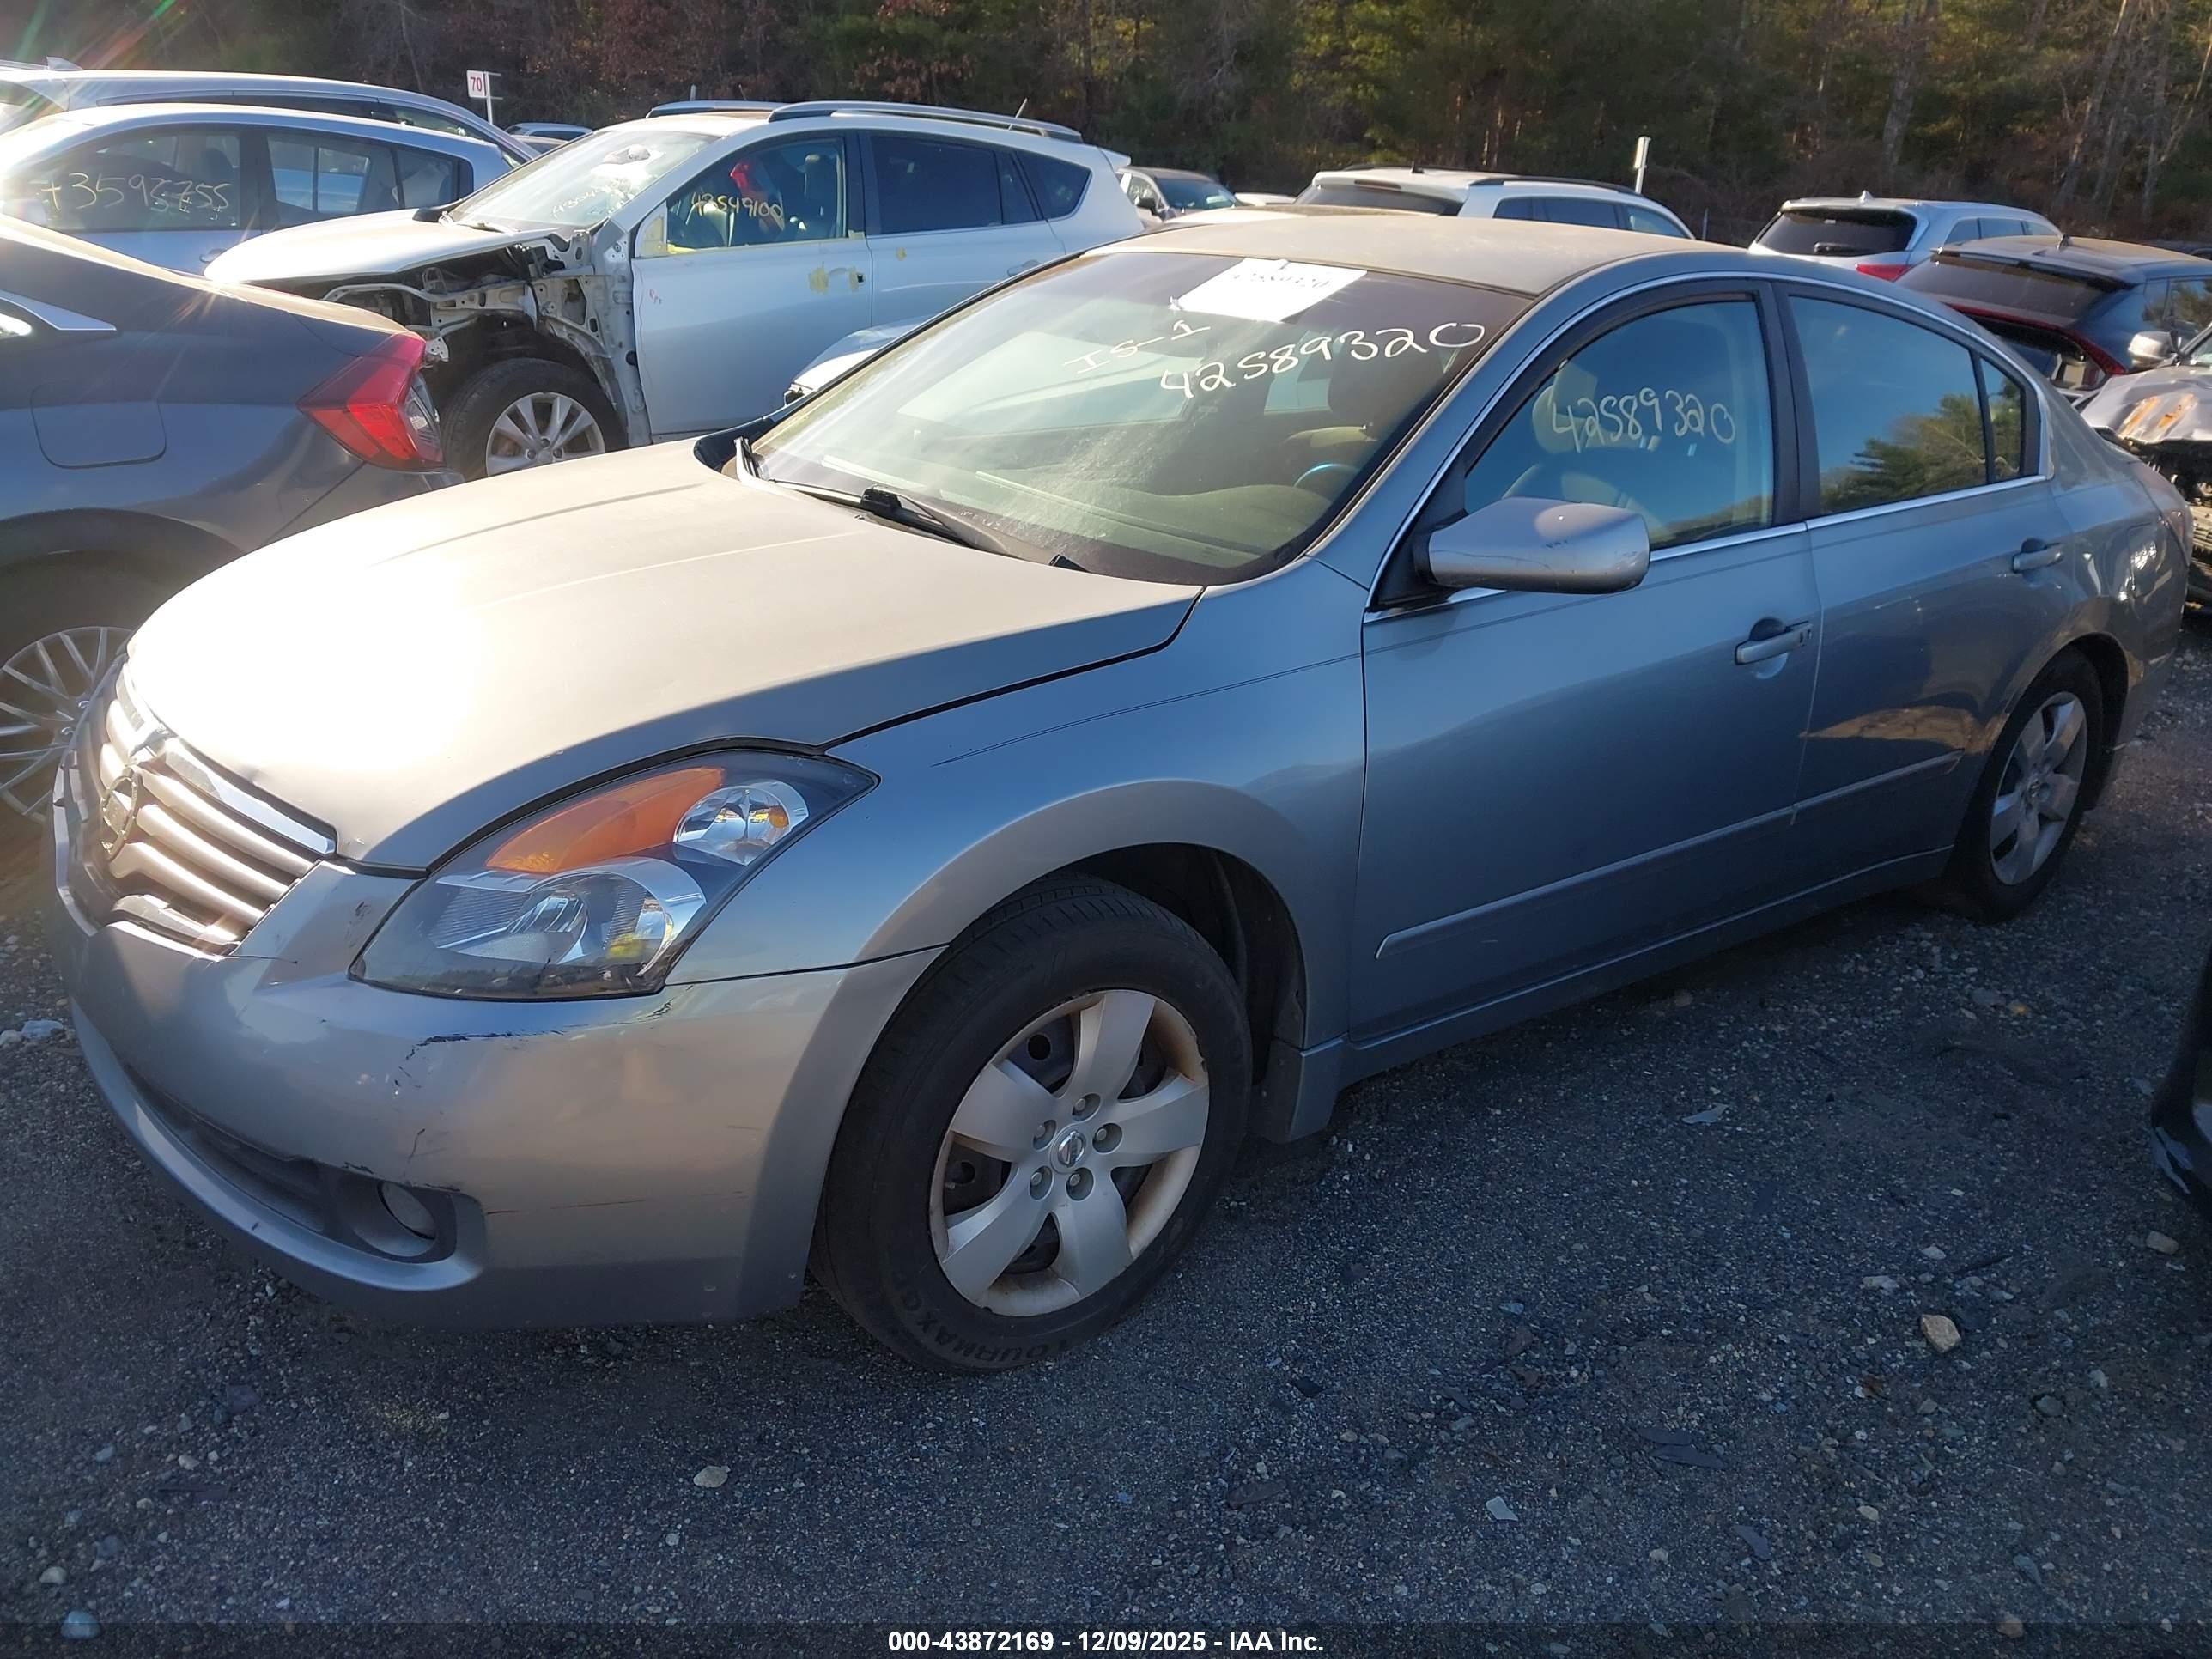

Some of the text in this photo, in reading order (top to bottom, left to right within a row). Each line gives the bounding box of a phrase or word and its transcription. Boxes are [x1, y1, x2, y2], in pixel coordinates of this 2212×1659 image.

[470, 76, 483, 92] 70
[1159, 321, 1486, 399] 42589320
[1548, 386, 1736, 454] 42589320
